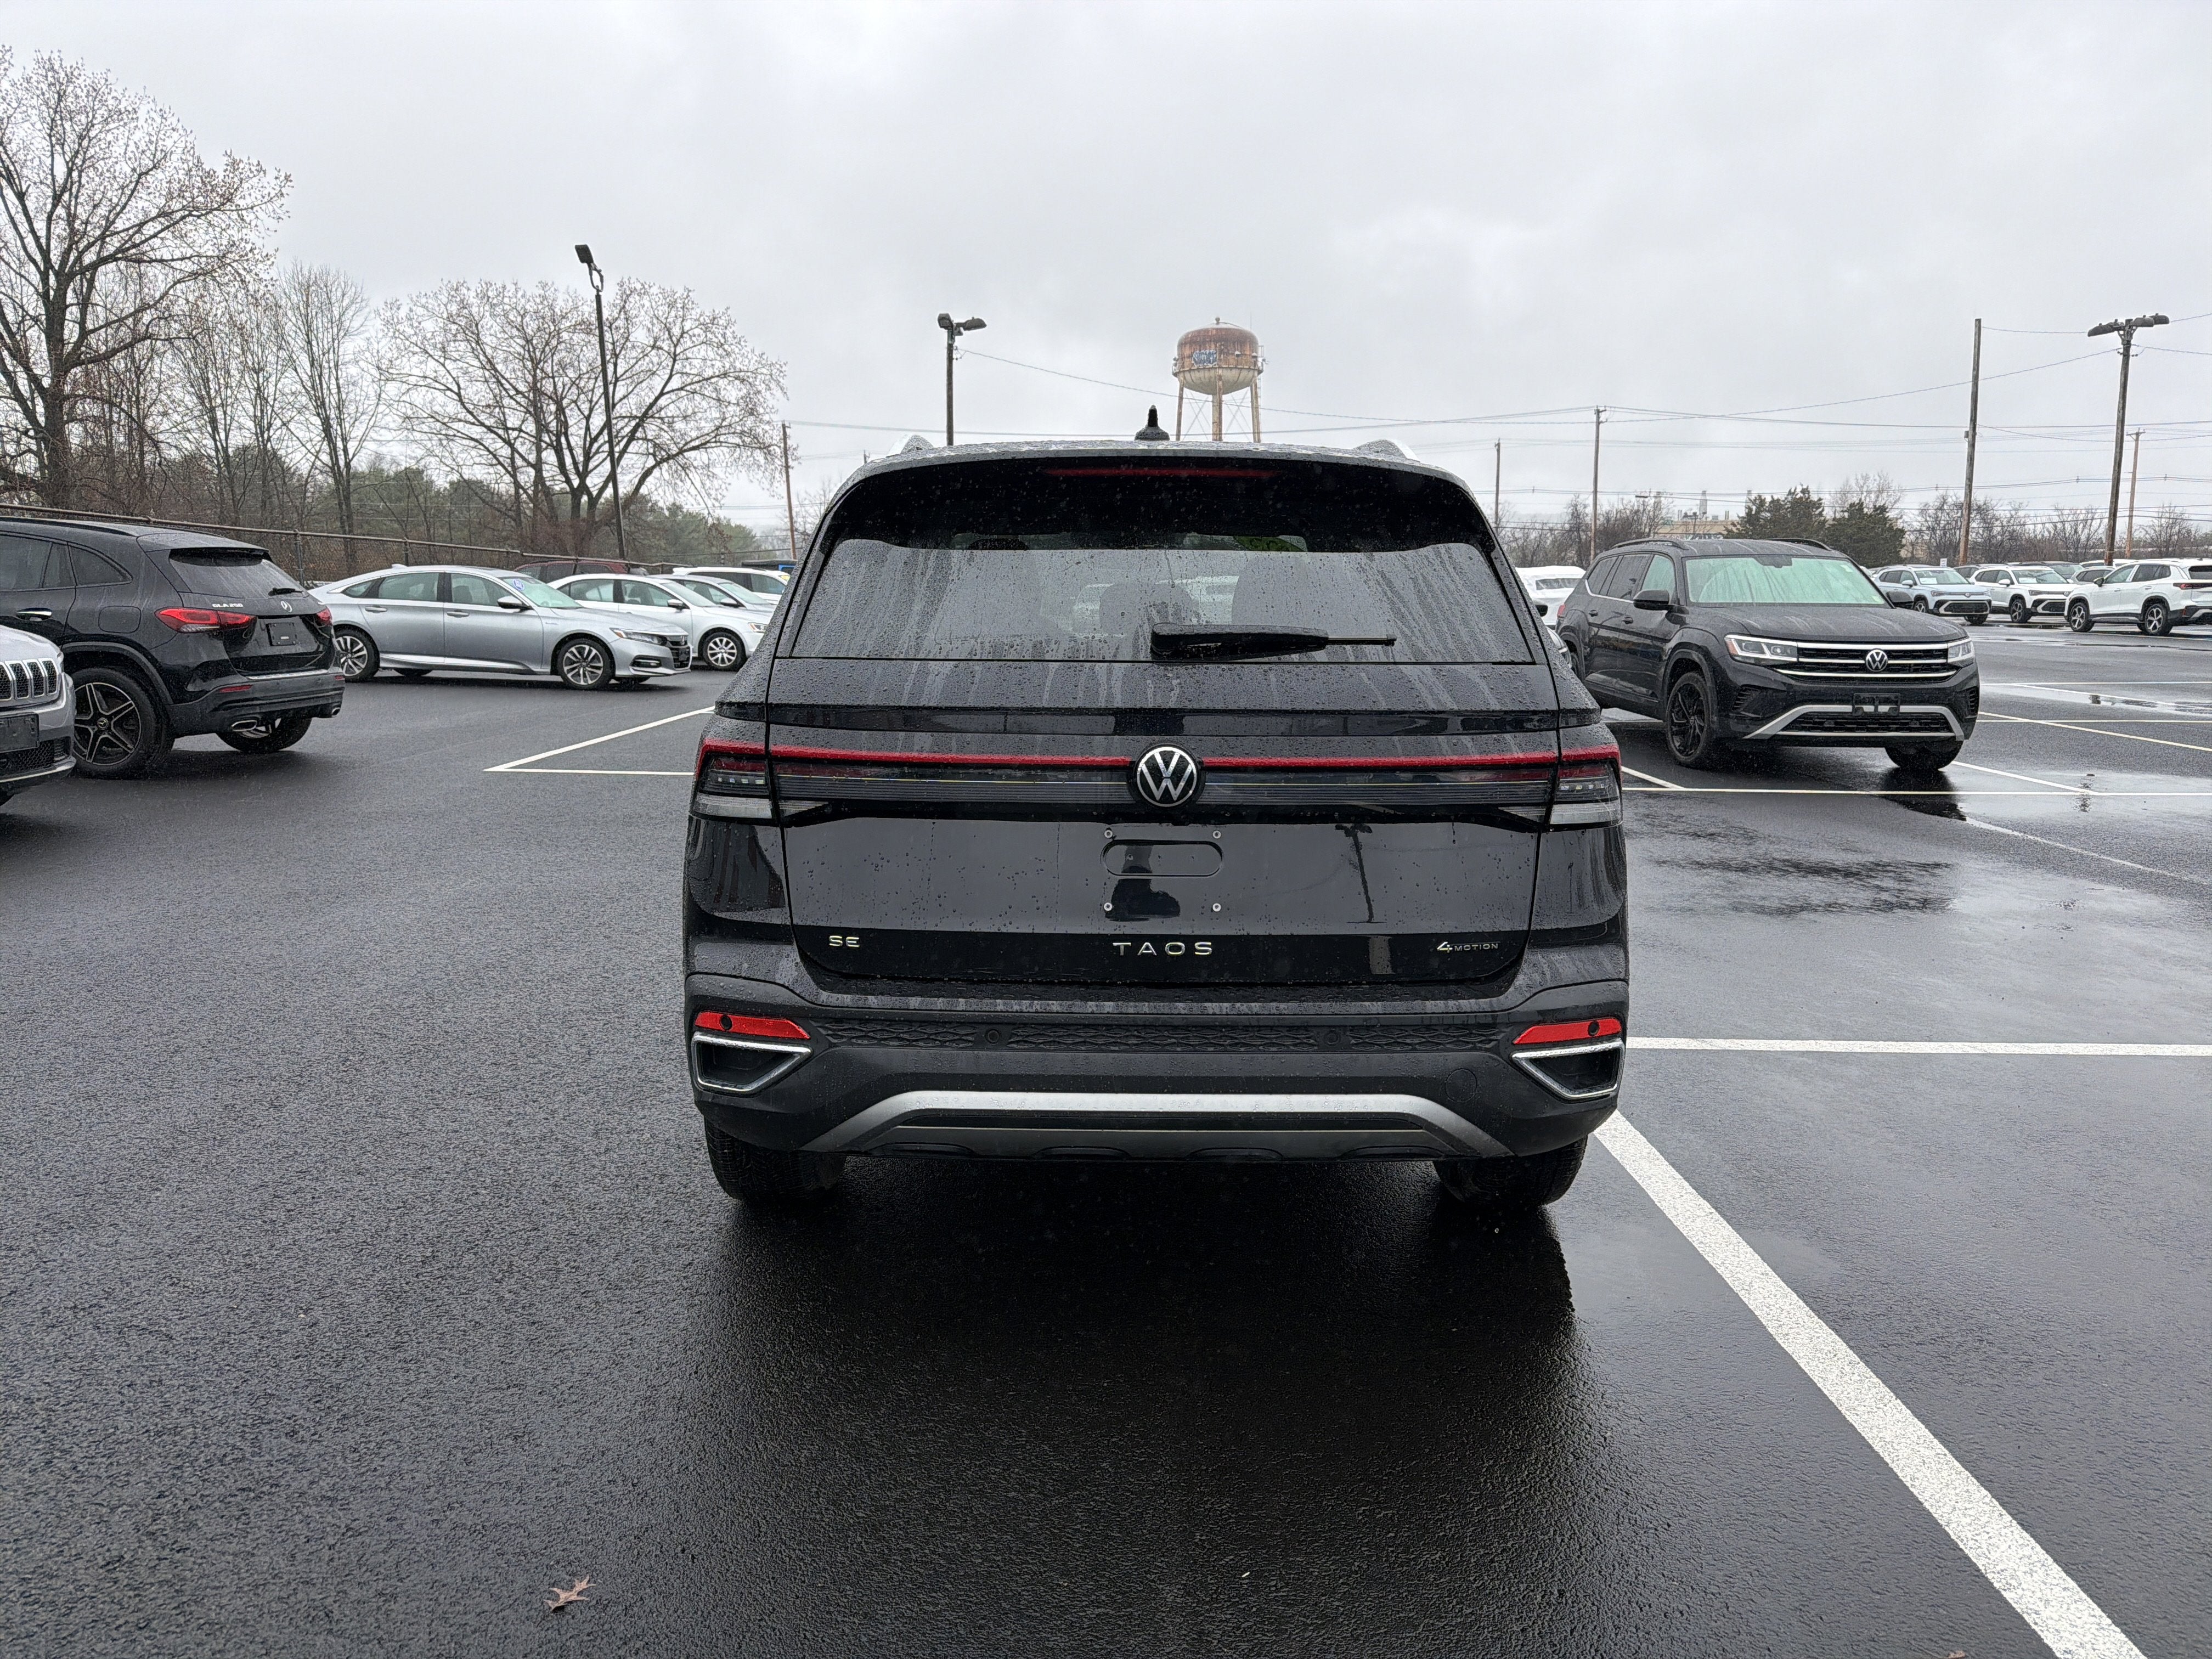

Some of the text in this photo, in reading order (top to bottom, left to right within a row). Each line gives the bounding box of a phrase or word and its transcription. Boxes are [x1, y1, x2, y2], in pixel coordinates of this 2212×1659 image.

[1866, 649, 1888, 672] VW
[1137, 747, 1197, 807] VW
[829, 935, 860, 947] SE
[1112, 941, 1212, 956] TAOS
[1437, 941, 1498, 953] 4MOTION
